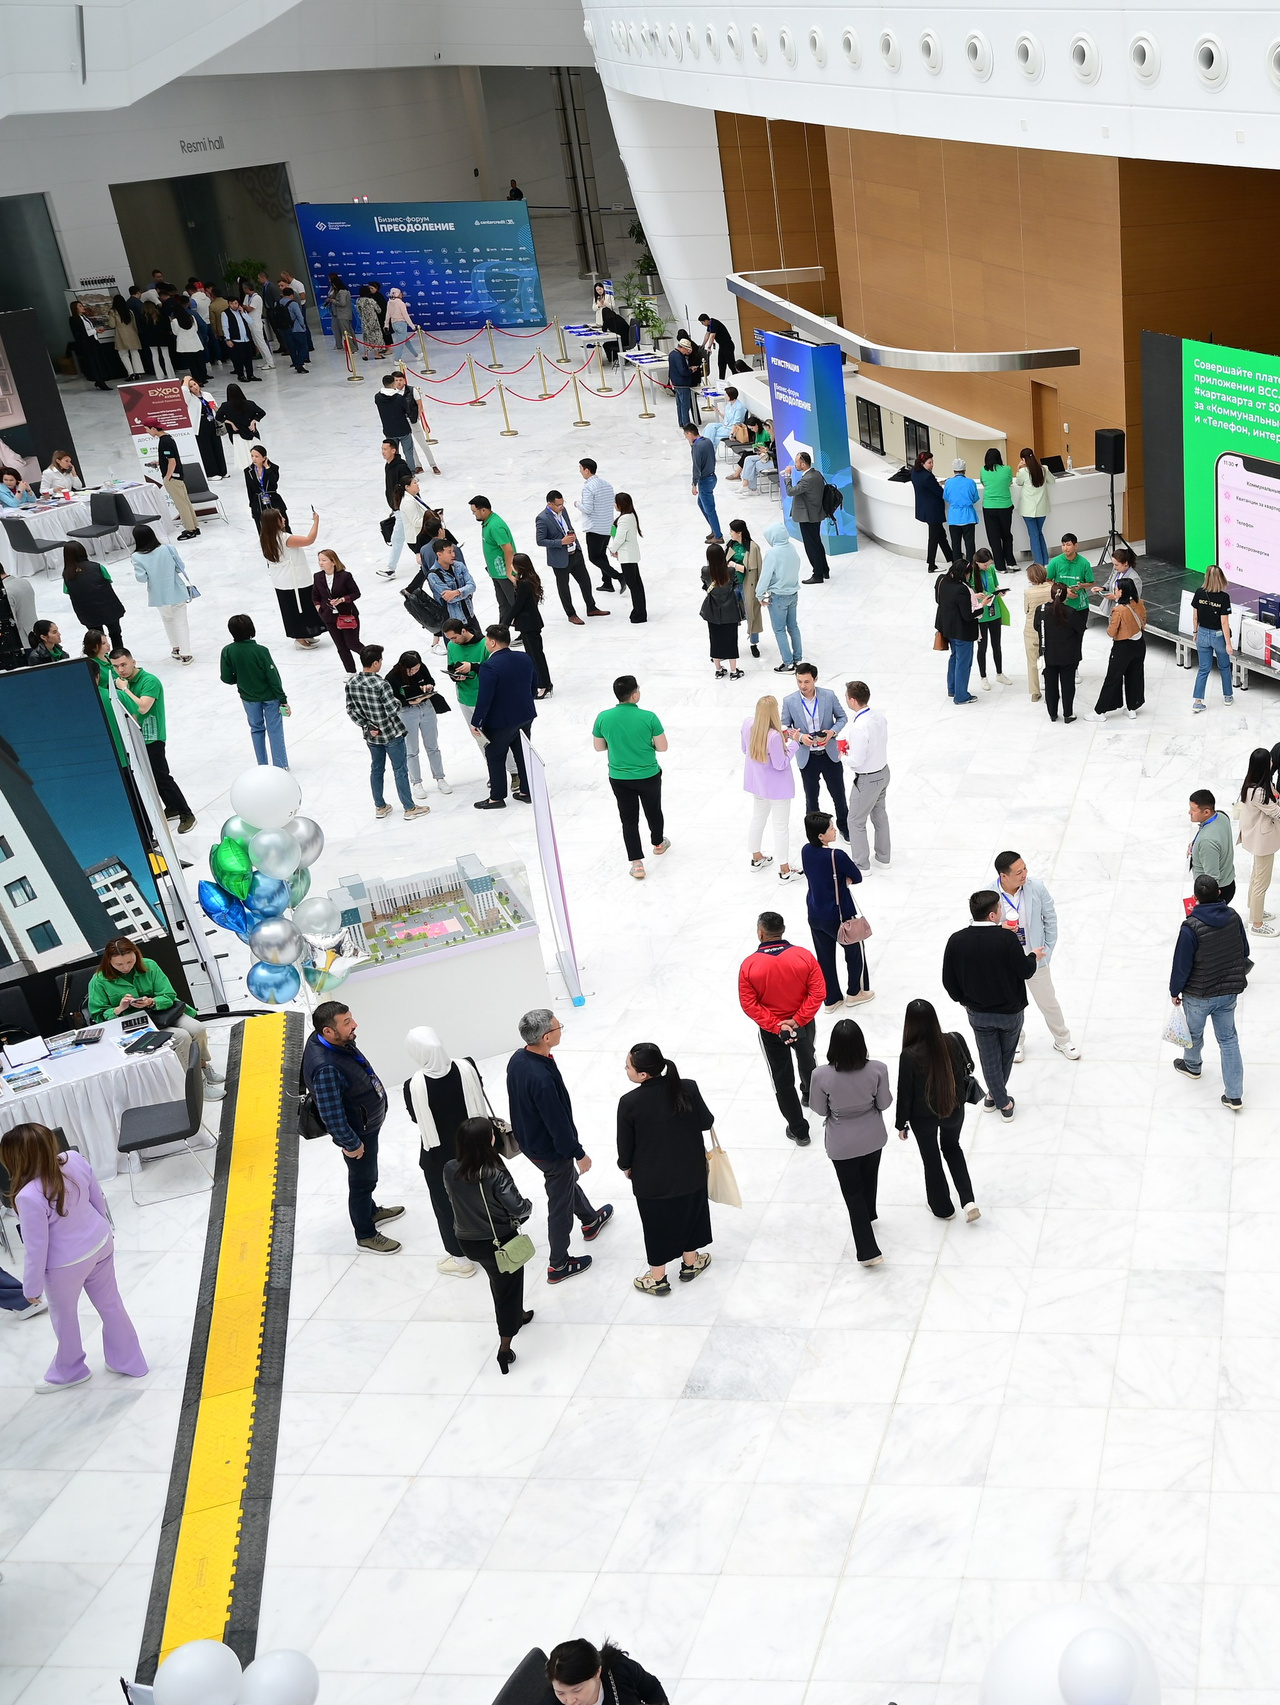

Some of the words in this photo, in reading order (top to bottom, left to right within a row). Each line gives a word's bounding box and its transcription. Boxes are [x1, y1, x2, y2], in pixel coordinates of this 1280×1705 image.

[180, 138, 207, 154] Resmi
[207, 136, 225, 150] hall
[379, 222, 456, 233] ПРЕОДОЛЕНИЕ
[771, 356, 800, 373] РЕГИСТРАЦИЯ
[1194, 358, 1253, 379] Совершайте
[1194, 374, 1255, 393] приложении
[776, 391, 812, 412] ПРЕОДОЛЕНИЕ
[1194, 386, 1253, 407] #картакарта
[1255, 401, 1266, 410] от
[1194, 401, 1204, 410] за
[1194, 415, 1200, 423] и
[1202, 416, 1250, 437] «Телефон,
[1246, 481, 1280, 494] Коммунальные
[1236, 519, 1254, 528] Телефон
[1236, 543, 1270, 557] Электроэнергия
